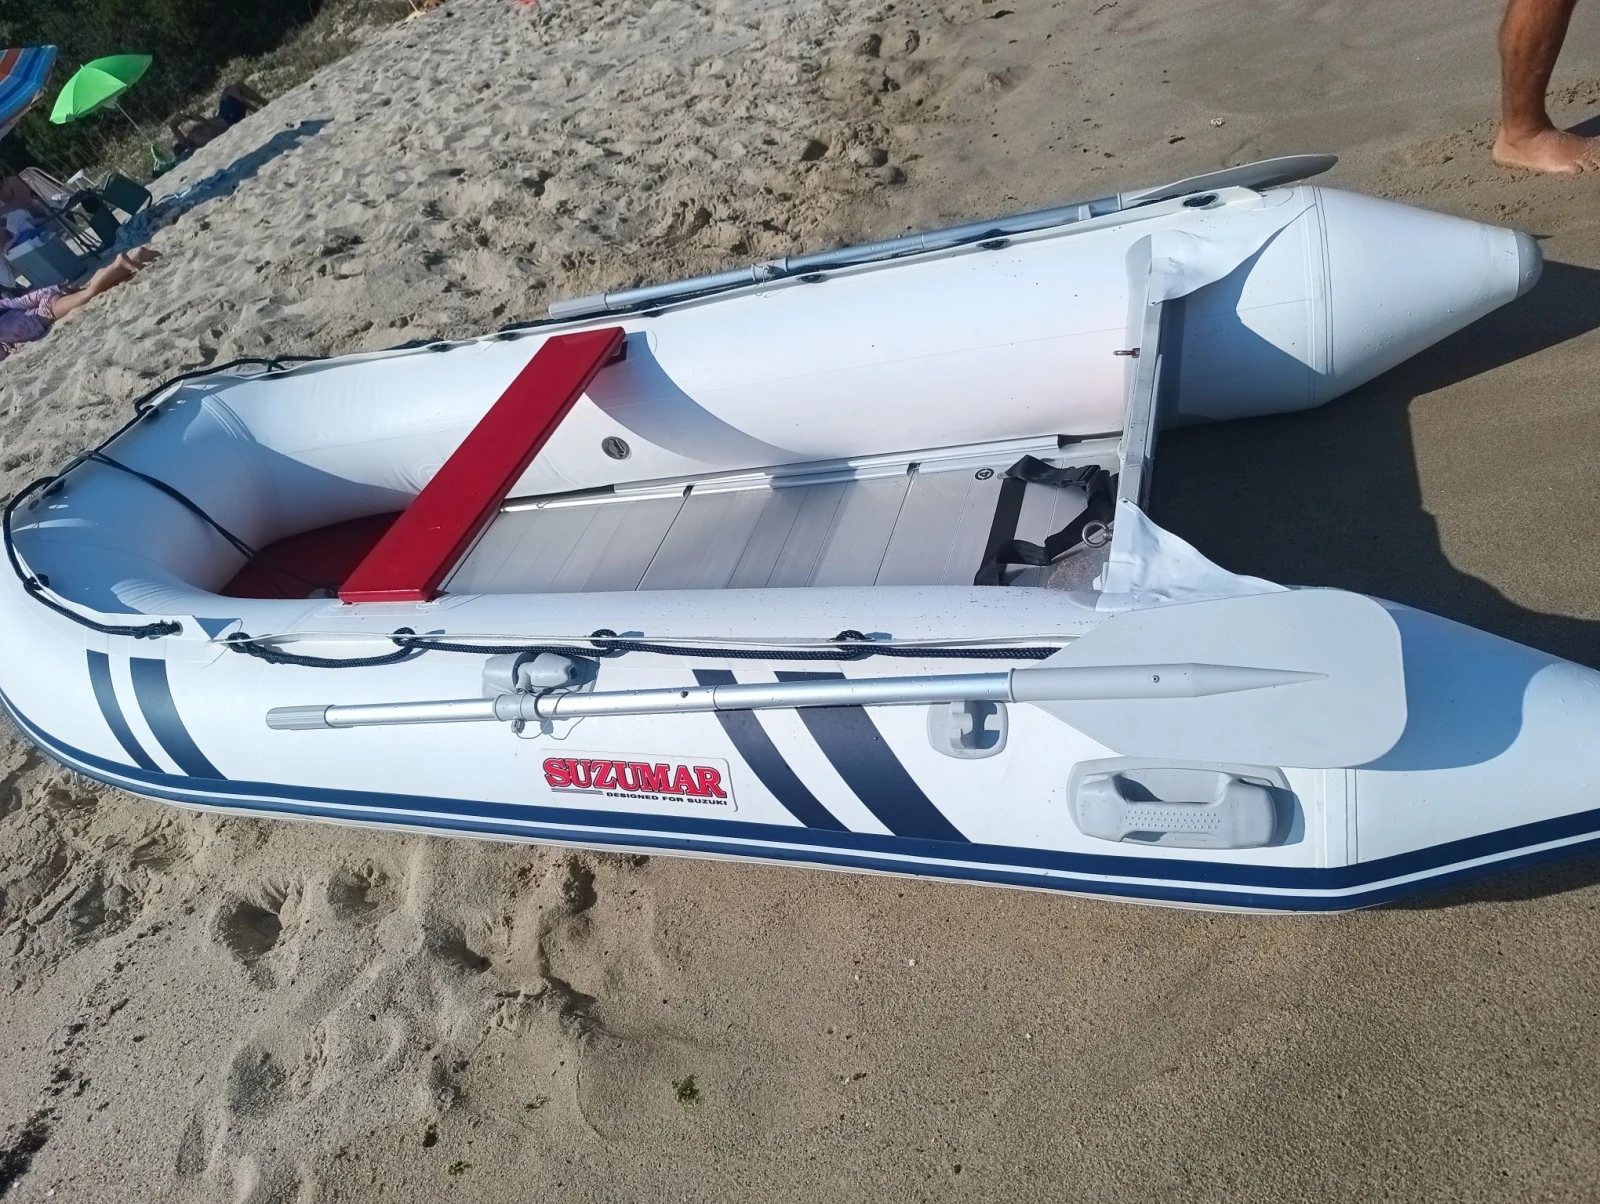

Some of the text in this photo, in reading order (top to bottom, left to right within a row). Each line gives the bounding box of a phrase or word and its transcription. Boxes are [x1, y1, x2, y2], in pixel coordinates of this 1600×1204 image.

[543, 757, 727, 798] SUZUMAR
[606, 792, 659, 801] DESIGNED
[687, 798, 728, 806] SUZUKI
